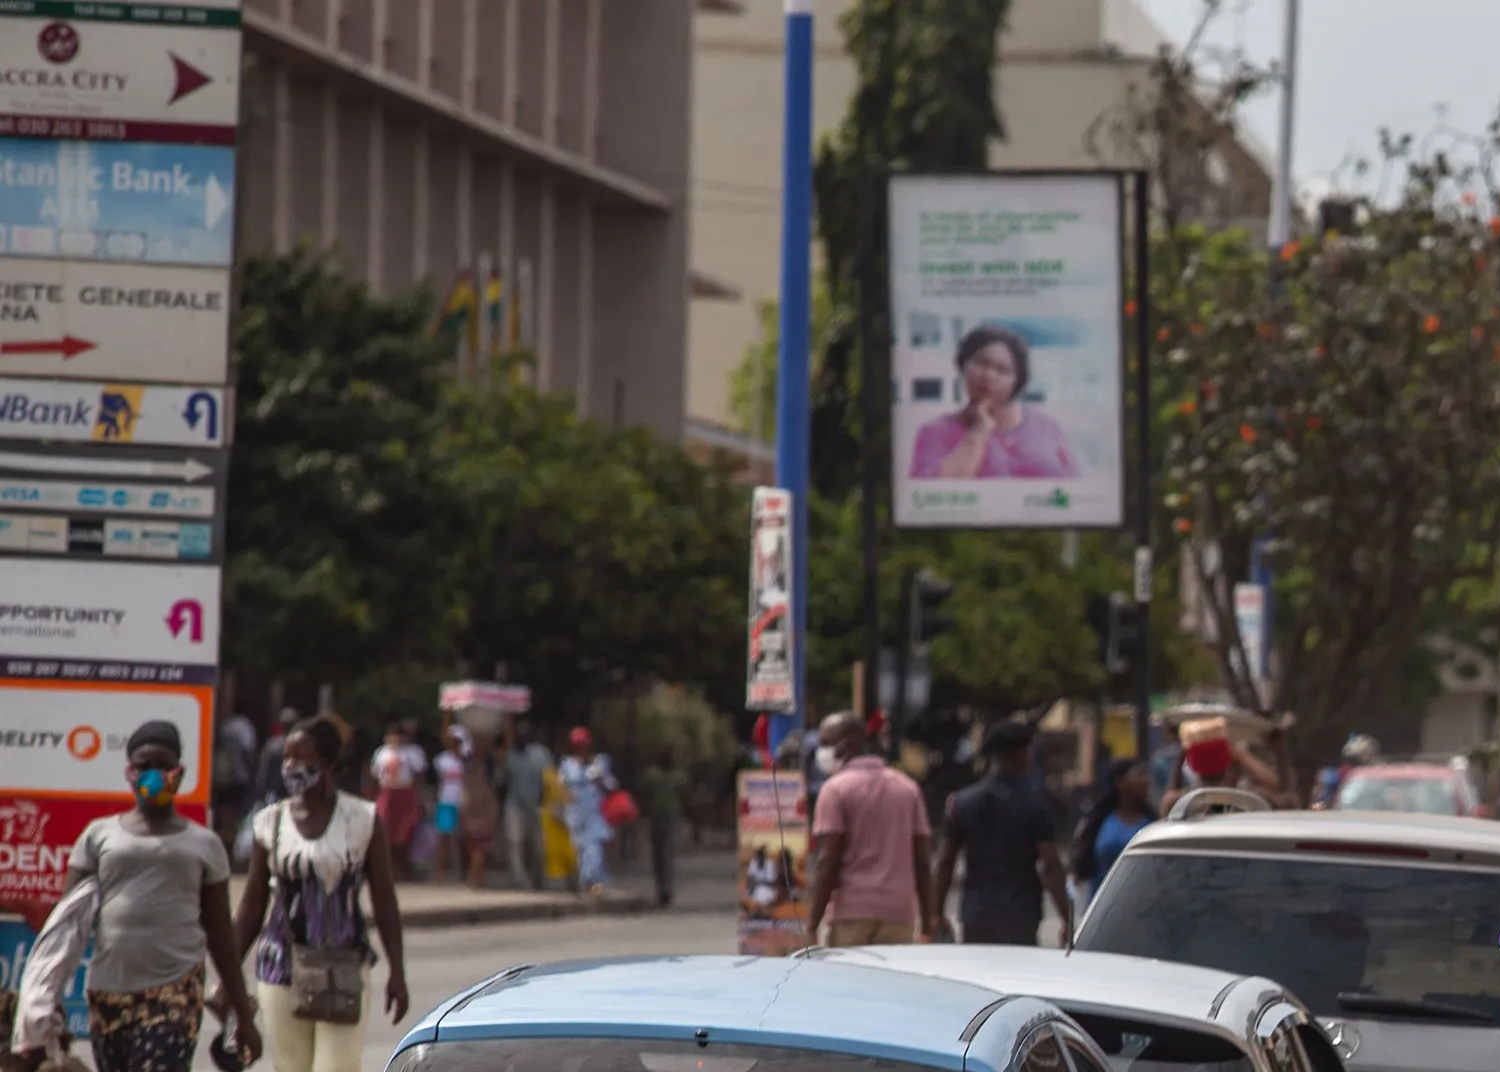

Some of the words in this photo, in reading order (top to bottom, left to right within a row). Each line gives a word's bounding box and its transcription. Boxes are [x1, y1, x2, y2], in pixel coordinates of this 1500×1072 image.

[0, 69, 66, 87] CCRA
[112, 161, 191, 195] Bank
[0, 282, 64, 303] IETE
[79, 285, 222, 311] GENERALE
[0, 730, 64, 749] ELITY
